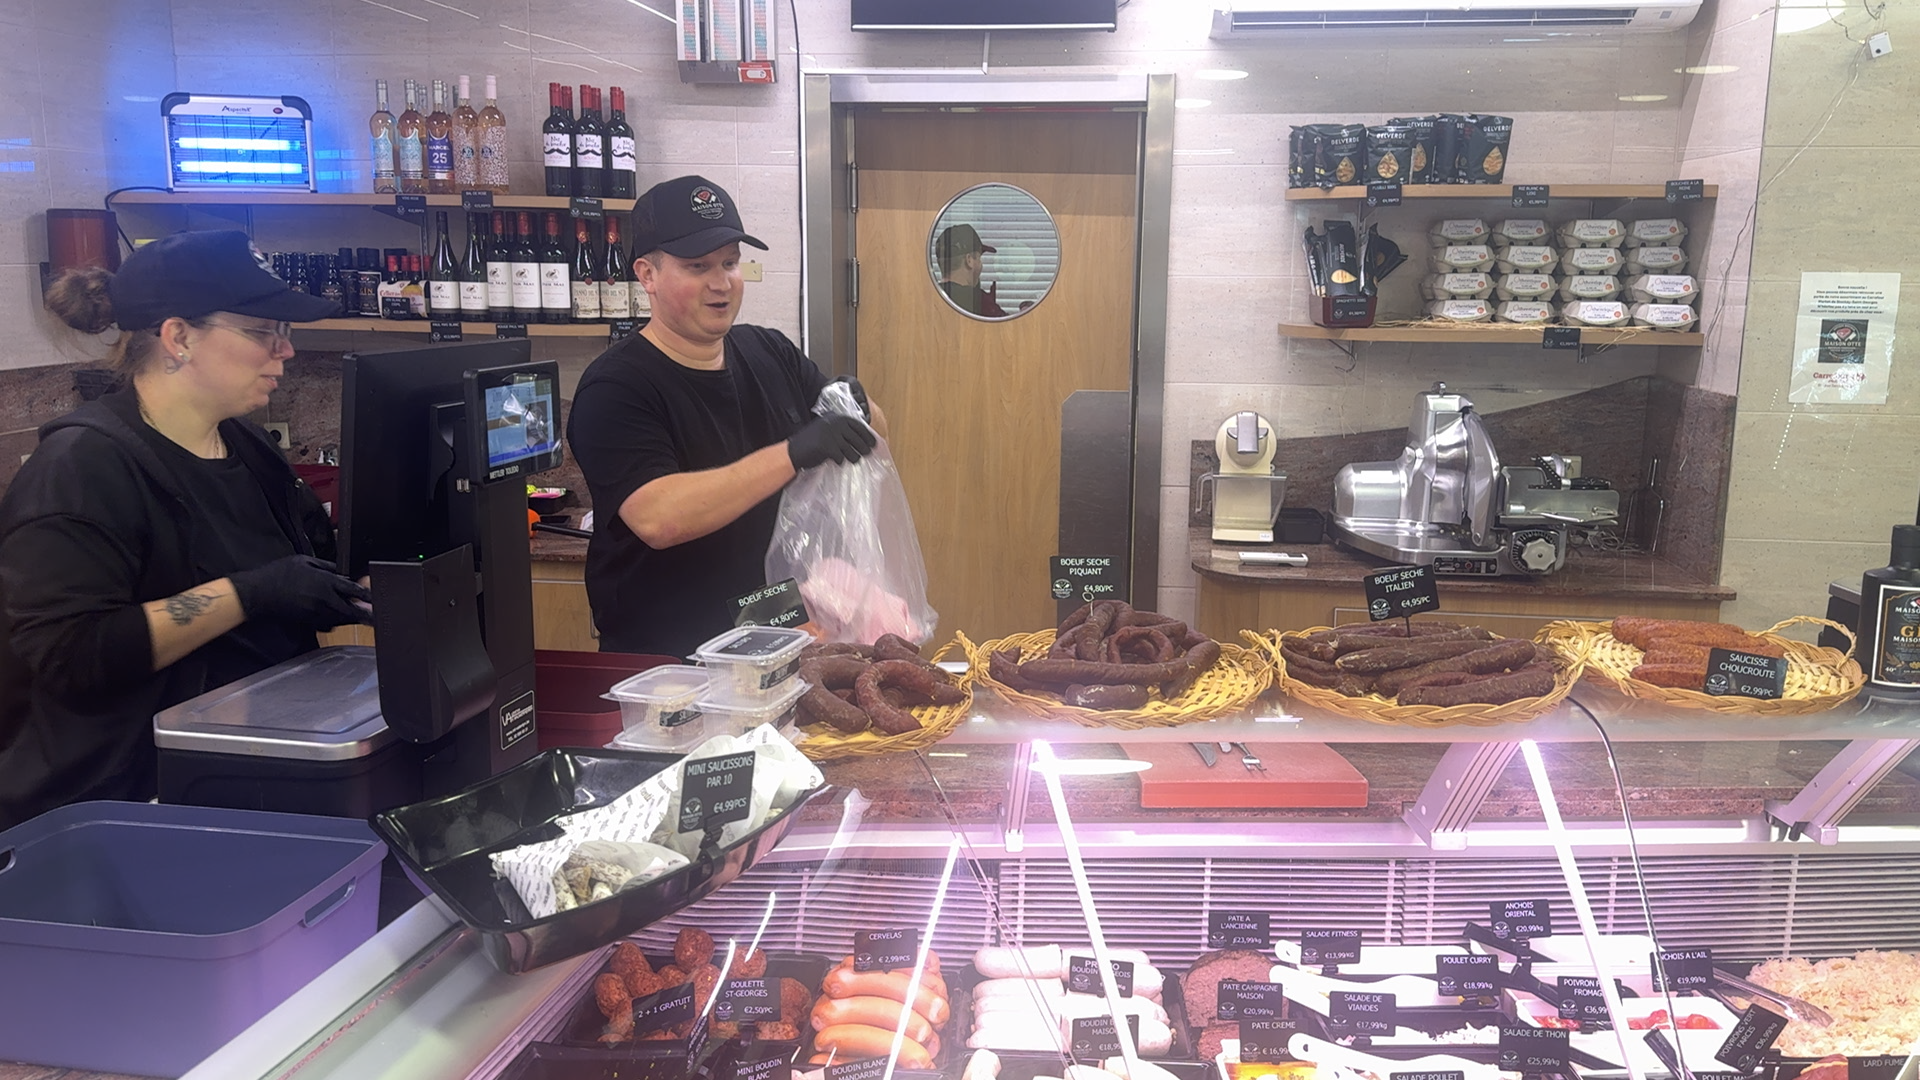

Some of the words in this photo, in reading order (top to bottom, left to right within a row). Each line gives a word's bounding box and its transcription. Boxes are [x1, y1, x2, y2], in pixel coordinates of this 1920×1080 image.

[1376, 132, 1406, 140] DELVERDE
[1331, 137, 1359, 145] DELVERDE
[432, 153, 448, 164] 25
[489, 469, 505, 480] METTLER
[505, 465, 519, 476] TOLEDO
[1060, 558, 1085, 566] BOEUF
[1086, 558, 1110, 566] SECHE
[1069, 568, 1102, 577] PIQUANT
[1374, 573, 1399, 585] BOEUF
[1400, 568, 1424, 580] SECHE
[1084, 584, 1114, 593] €4,80/PC
[1385, 580, 1415, 593] ITALIEN
[738, 591, 763, 607] BOEUF
[763, 583, 788, 599] SECHE
[1401, 595, 1430, 608] €4,95/PC
[770, 610, 799, 627] €4,80/PC
[1729, 653, 1768, 667] SAUCISSE
[1719, 662, 1775, 679] CHOUCROUTE
[1741, 685, 1773, 697] €2,99/PC
[687, 763, 707, 776] MINI
[707, 755, 754, 773] SAUCISSONS
[706, 776, 722, 788] PAR
[723, 773, 733, 785] 10
[713, 797, 747, 813] €4,99/PCS
[1504, 910, 1535, 918] ORIENTAL
[869, 932, 902, 941] CERVELAS
[884, 955, 911, 963] 2,99/PCS
[1071, 966, 1098, 975] BOUDIN
[731, 980, 765, 988] BOULETTE
[1563, 978, 1595, 987] POIVRON
[1677, 976, 1706, 984] €19,99/kg
[1241, 984, 1278, 992] CAMPAGNE
[1463, 981, 1492, 989] €18,99/kg
[725, 989, 768, 997] ST-GEORGES
[1574, 989, 1603, 997] FROMAG
[1344, 994, 1371, 1002] SALADE
[638, 1010, 643, 1018] 2
[659, 995, 691, 1012] GRATUIT
[744, 1006, 773, 1014] €2,50/PC
[1347, 1004, 1378, 1012] VIANDES
[1243, 1008, 1274, 1016] €20,99/kg
[1356, 1021, 1387, 1030] €17,99/kg
[1092, 1027, 1117, 1035] MAISO
[1503, 1028, 1531, 1038] SALADE
[1533, 1029, 1544, 1038] DE
[1546, 1029, 1566, 1039] THON
[1720, 1024, 1745, 1058] POIVRONS
[1742, 1009, 1756, 1026] VERT
[1737, 1025, 1756, 1048] FARCIS
[1755, 1023, 1778, 1050] €36,99/kg
[1527, 1057, 1560, 1066] €25,99/kg
[1884, 1058, 1905, 1066] FUME
[737, 1065, 755, 1076] MINI
[755, 1058, 783, 1071] BOUDIN
[832, 1063, 861, 1075] BOUDIN
[863, 1058, 886, 1070] BLANC
[748, 1071, 770, 1080] BLANC
[838, 1069, 882, 1080] MANDARINE
